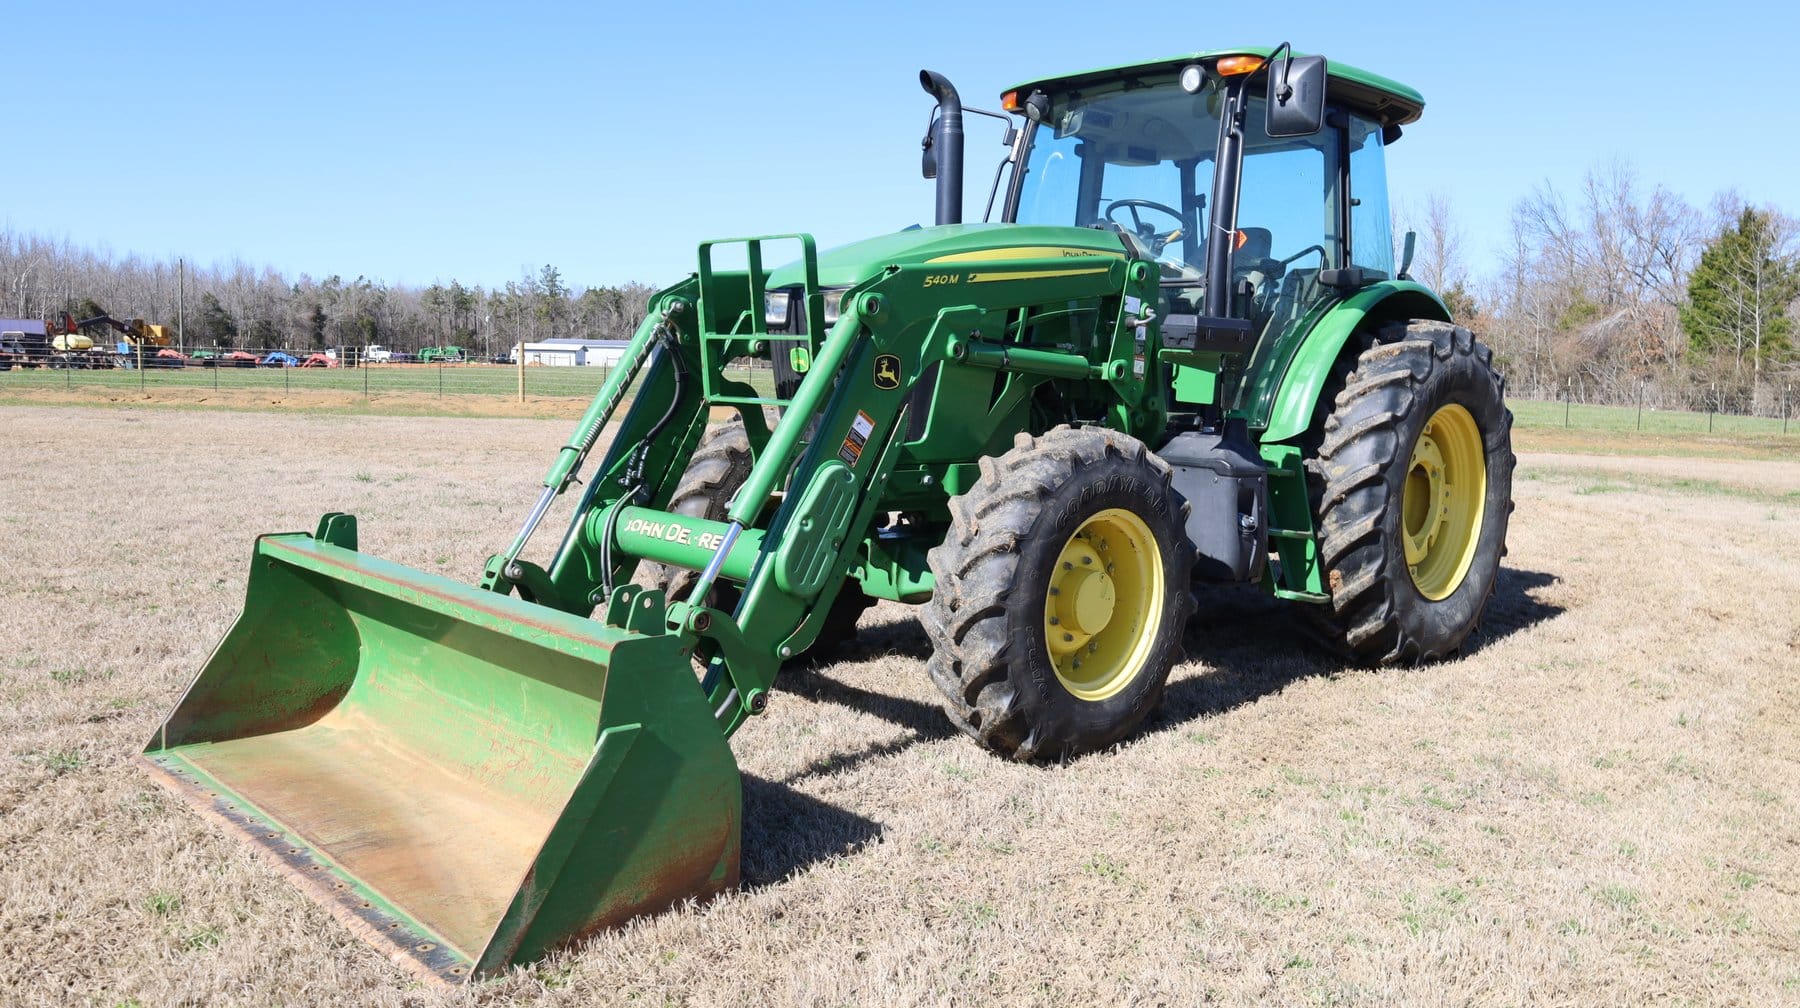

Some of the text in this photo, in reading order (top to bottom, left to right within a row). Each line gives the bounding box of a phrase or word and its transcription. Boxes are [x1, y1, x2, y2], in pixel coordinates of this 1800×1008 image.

[923, 273, 960, 289] 540M
[624, 518, 725, 550] JOHN DERE
